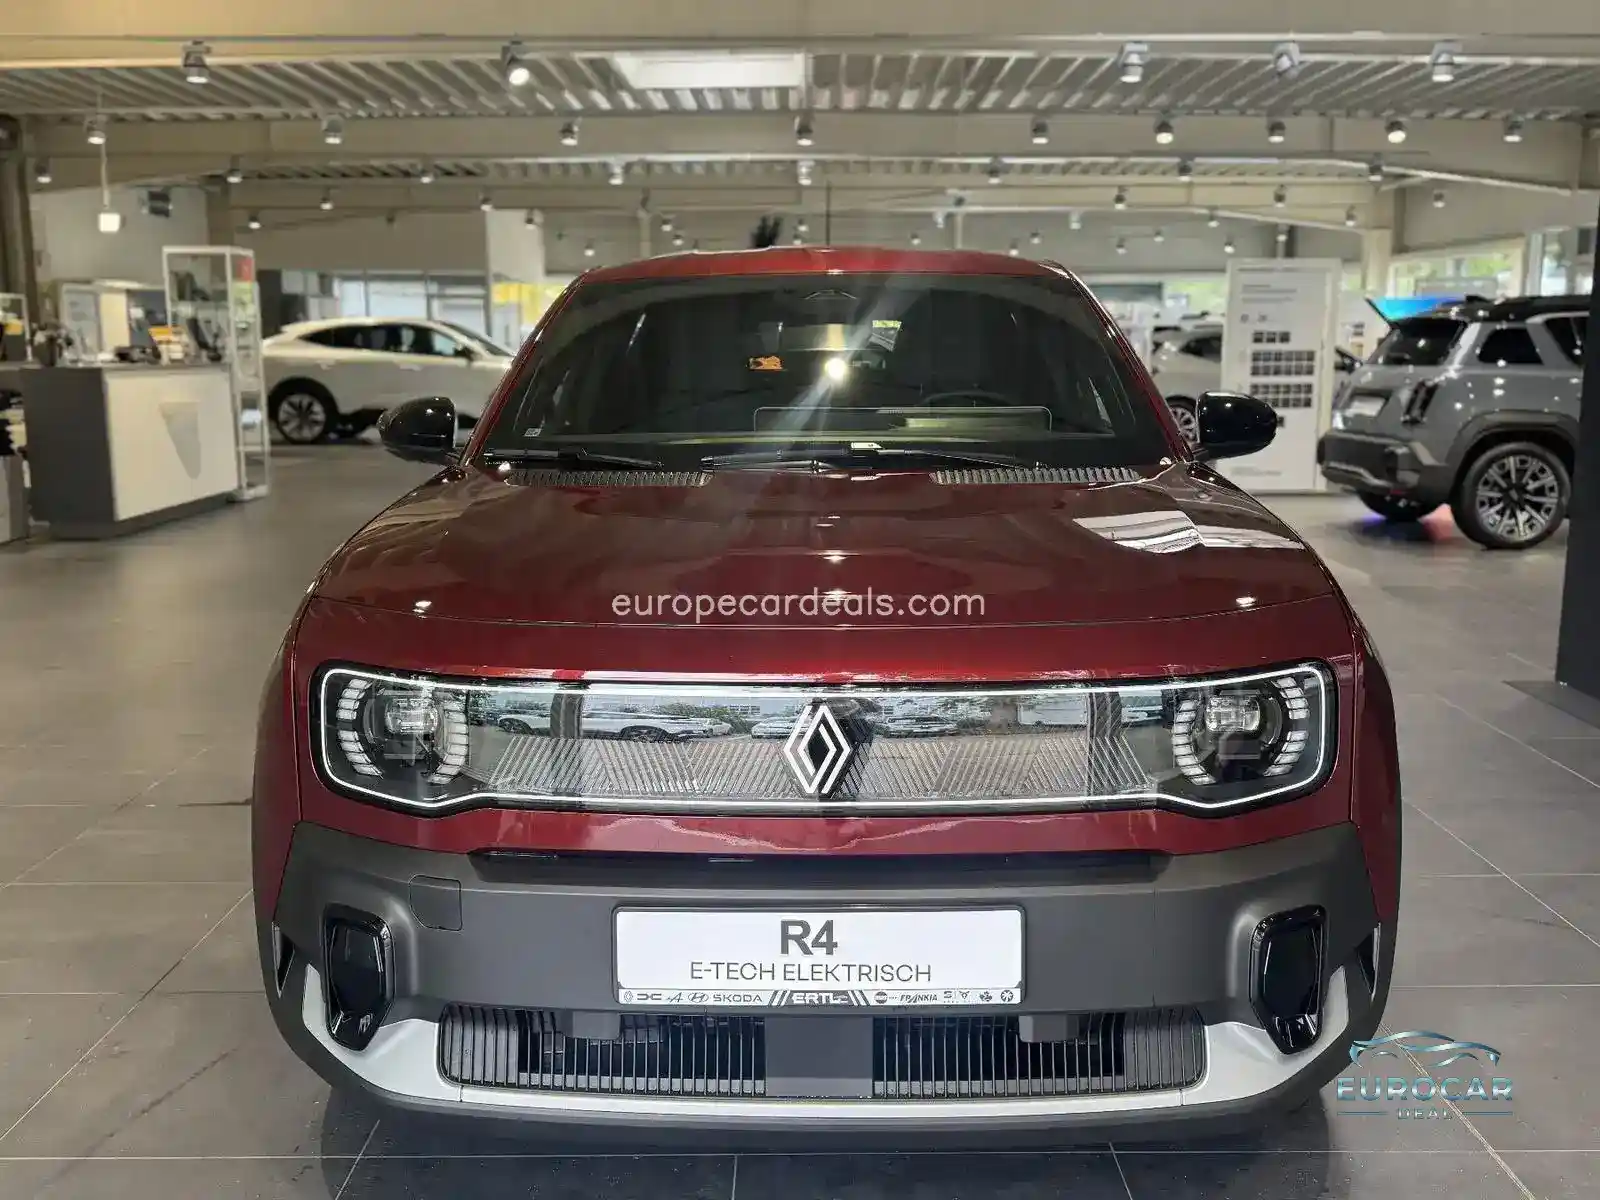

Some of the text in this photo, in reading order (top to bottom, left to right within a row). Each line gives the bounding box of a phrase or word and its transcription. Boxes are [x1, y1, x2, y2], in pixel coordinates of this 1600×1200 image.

[780, 919, 838, 956] R4
[690, 961, 931, 983] E-TECH ELEKTRISCH
